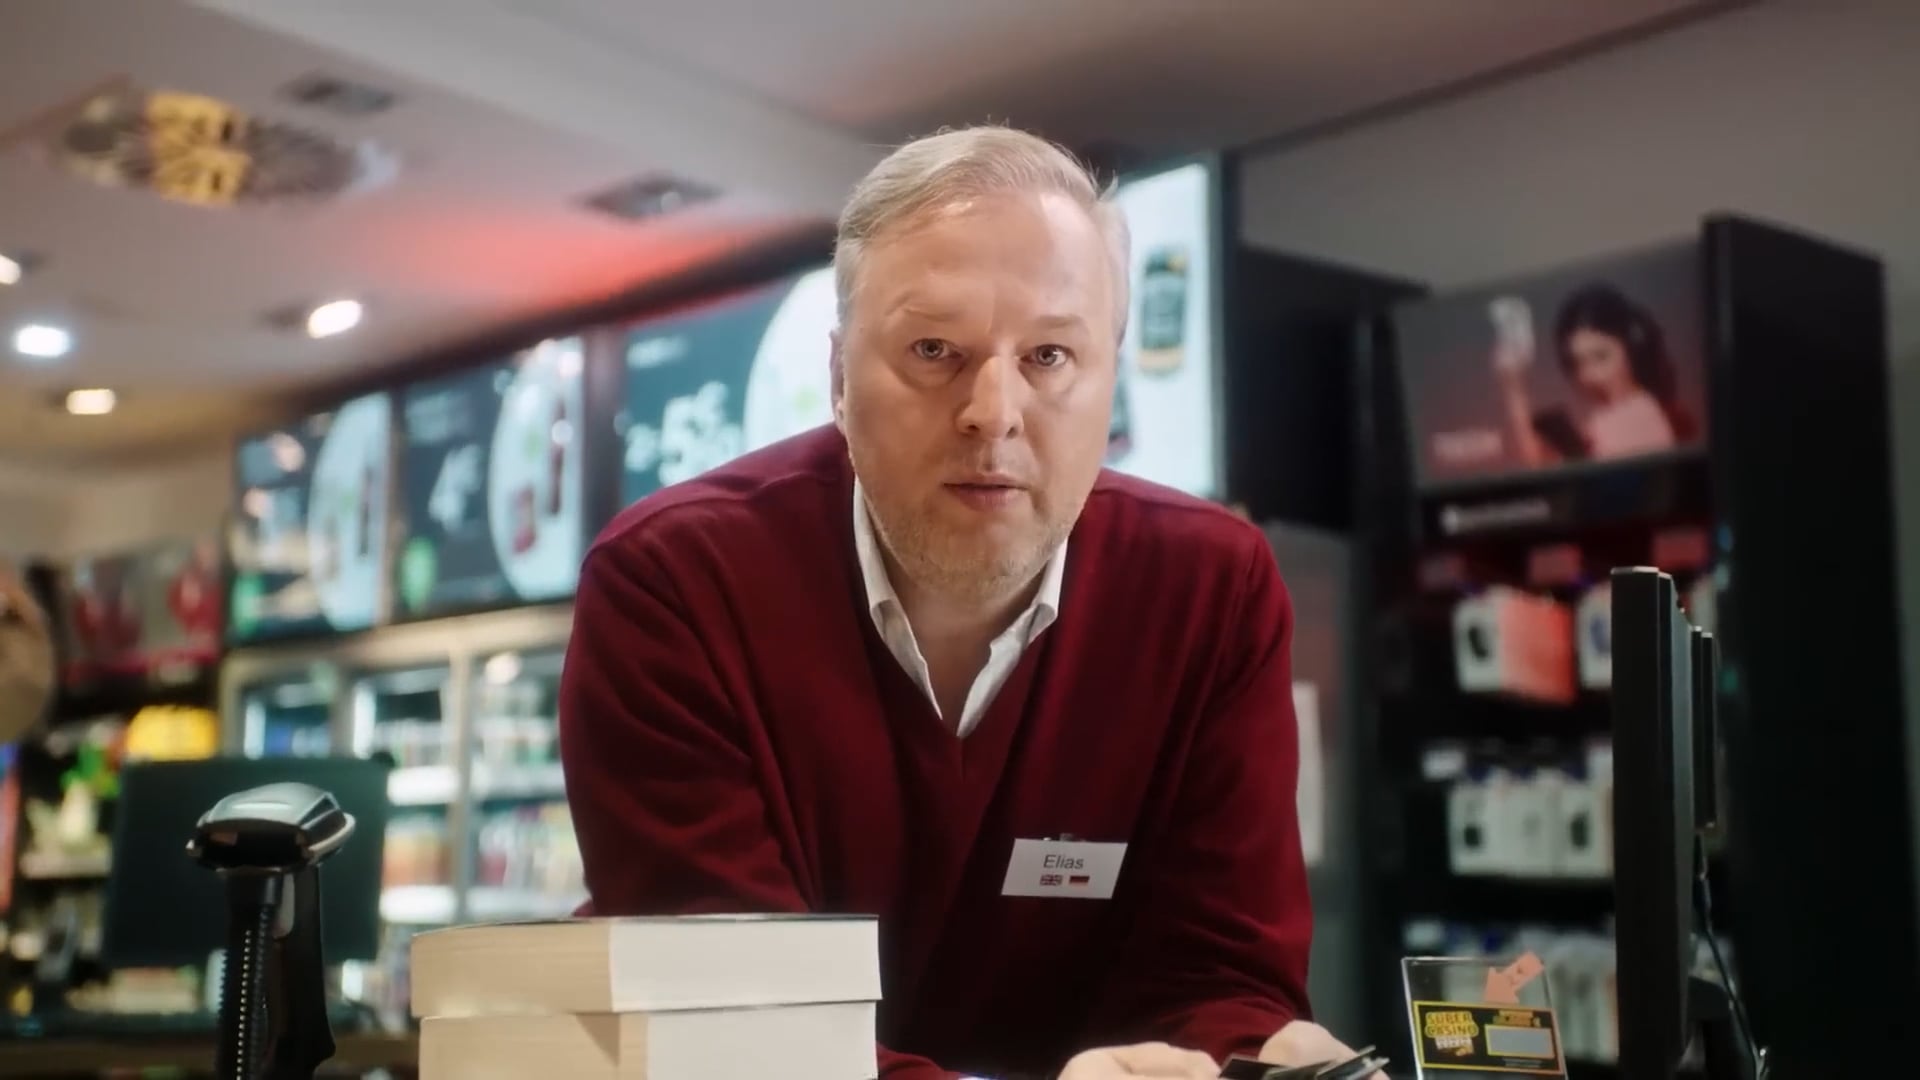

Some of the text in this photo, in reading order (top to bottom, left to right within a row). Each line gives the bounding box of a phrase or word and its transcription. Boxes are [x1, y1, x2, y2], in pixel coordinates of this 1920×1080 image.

[1043, 854, 1085, 870] Elias
[1427, 1012, 1471, 1025] SUPER
[1426, 1024, 1478, 1037] CASINO
